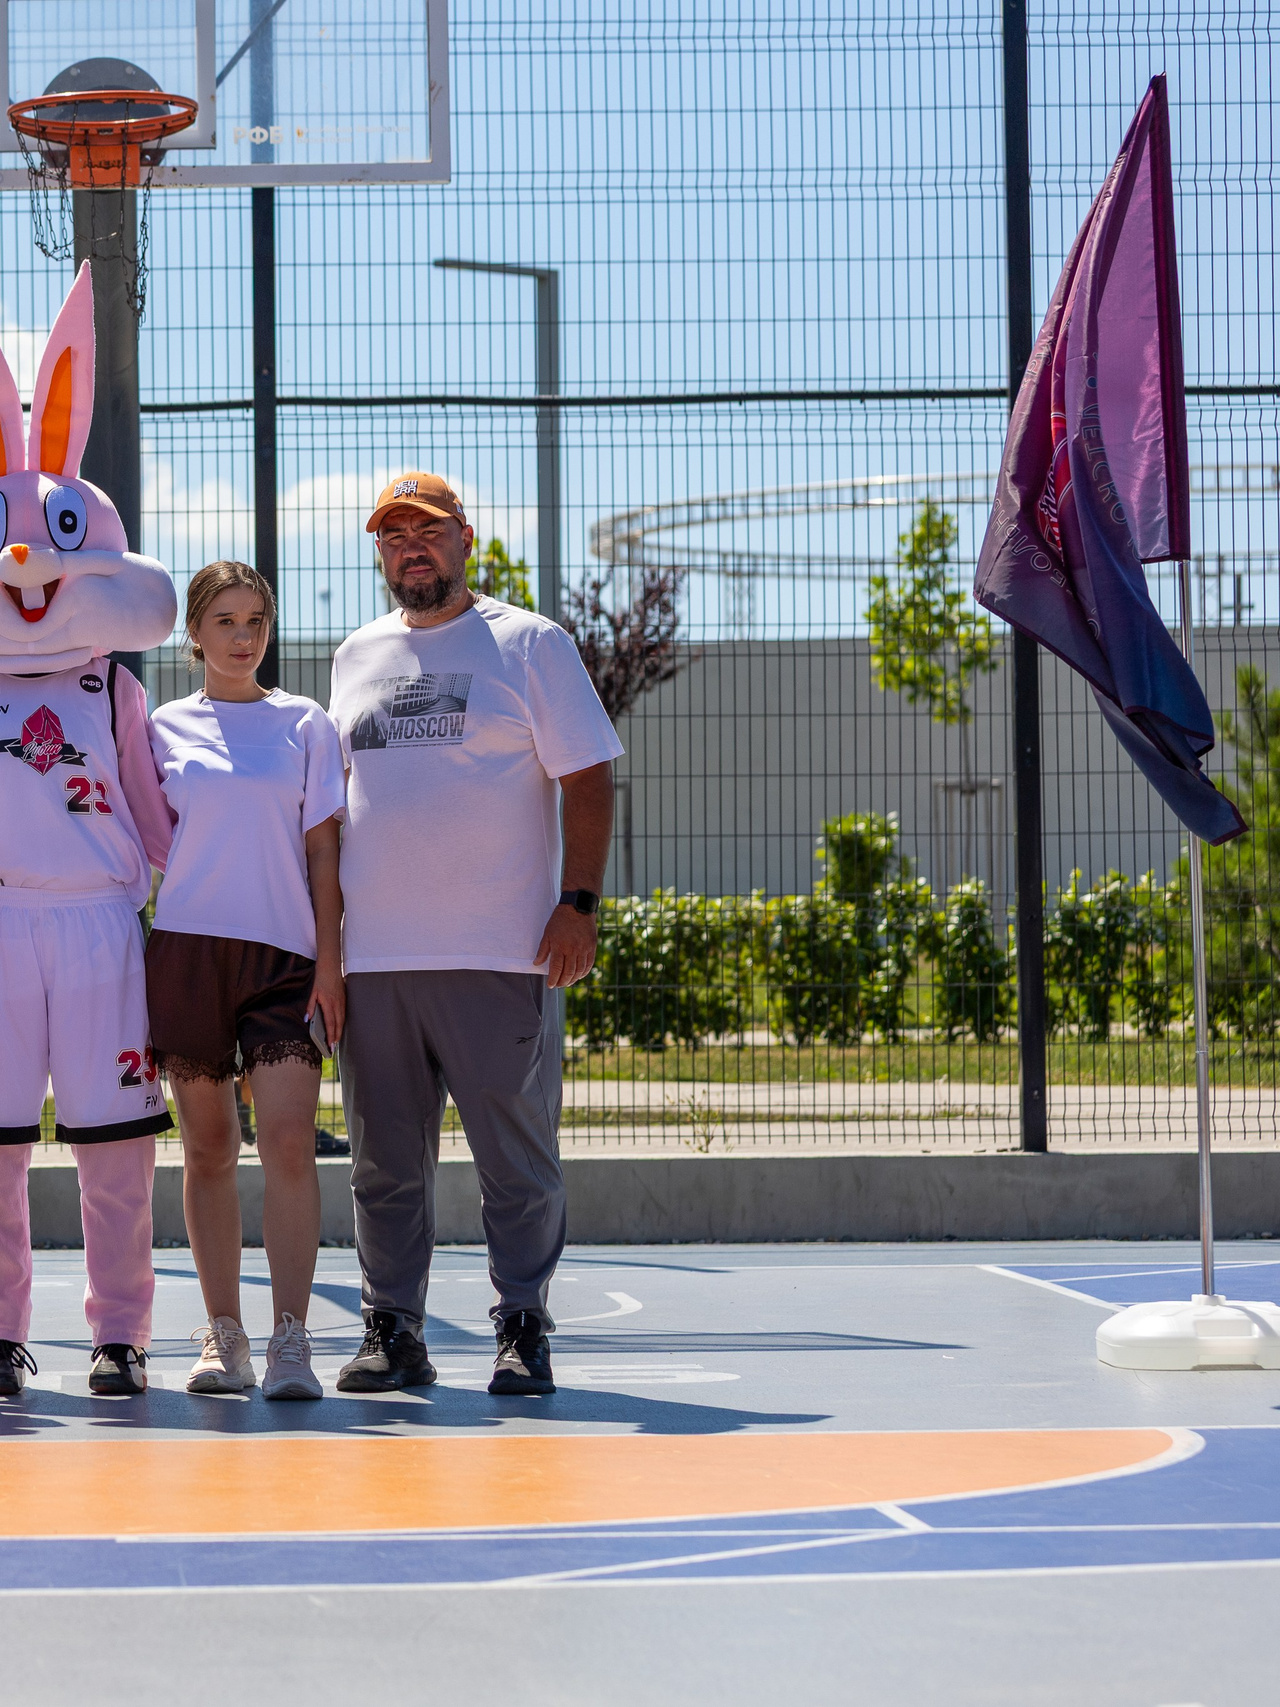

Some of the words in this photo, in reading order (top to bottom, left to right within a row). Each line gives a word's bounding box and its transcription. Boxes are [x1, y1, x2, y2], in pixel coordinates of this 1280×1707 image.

[233, 126, 284, 145] РФБ
[393, 486, 418, 499] ERA
[394, 480, 418, 491] NEW
[81, 679, 102, 689] РФБ
[387, 714, 466, 740] MOSCOW
[65, 775, 114, 816] 23
[115, 1044, 159, 1090] 23
